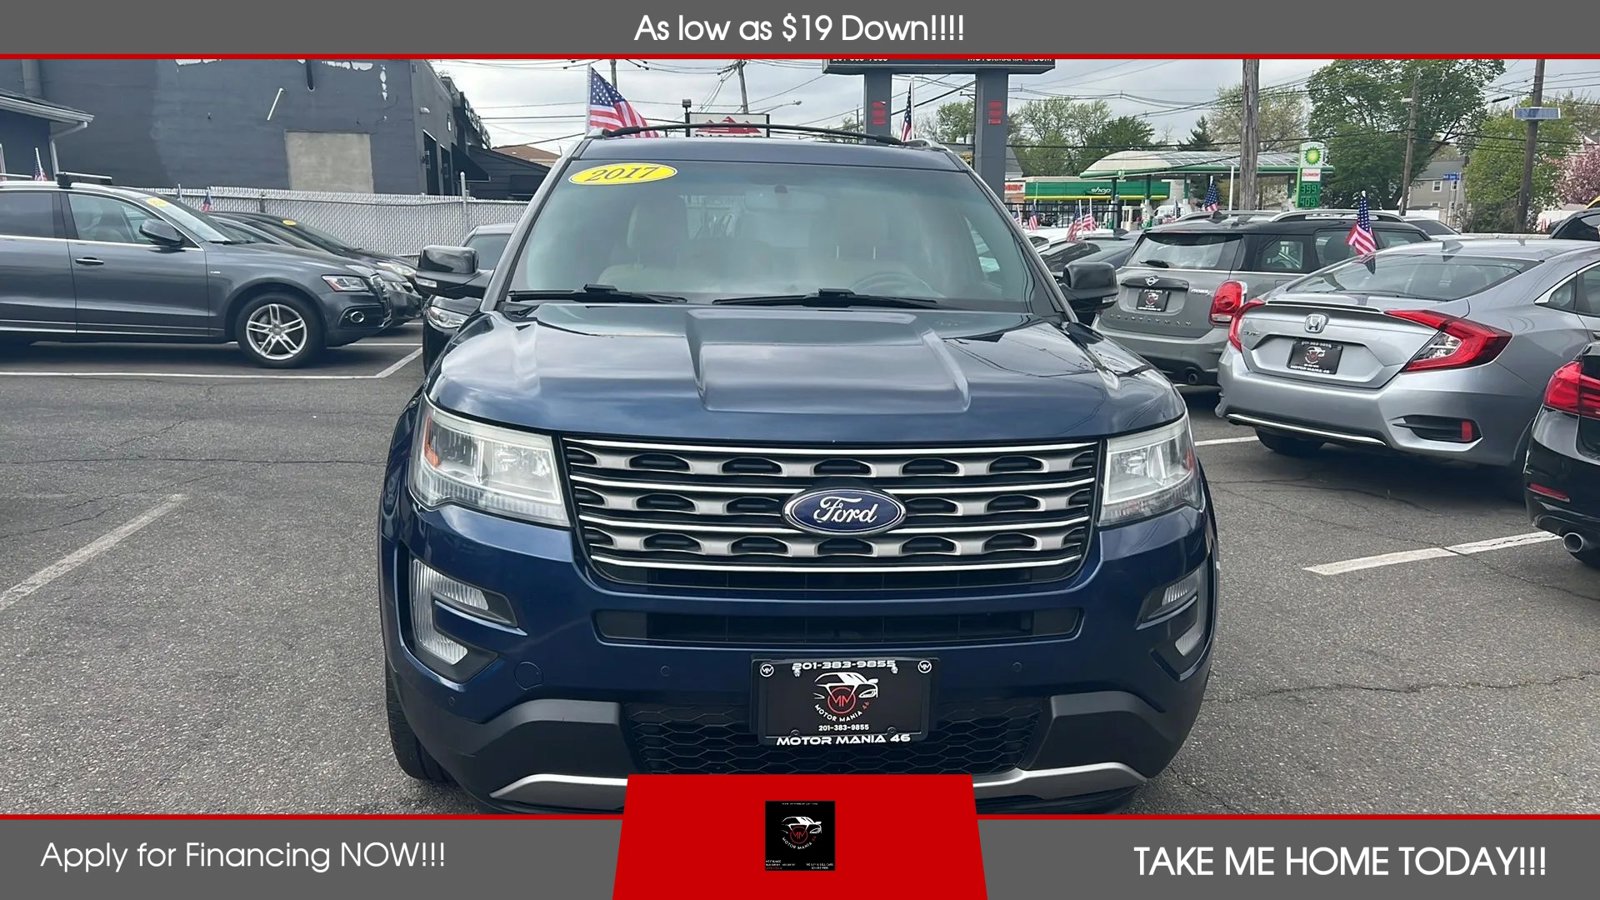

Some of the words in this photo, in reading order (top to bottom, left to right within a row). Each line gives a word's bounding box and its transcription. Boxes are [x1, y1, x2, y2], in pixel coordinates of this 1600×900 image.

[584, 166, 659, 182] 2017
[813, 496, 879, 523] Ford
[814, 704, 838, 722] MOTOR
[839, 710, 863, 722] MANIA
[818, 723, 870, 732] 201-383-9855
[776, 736, 832, 746] MOTOR
[835, 734, 887, 745] MANIA
[890, 733, 911, 743] 46
